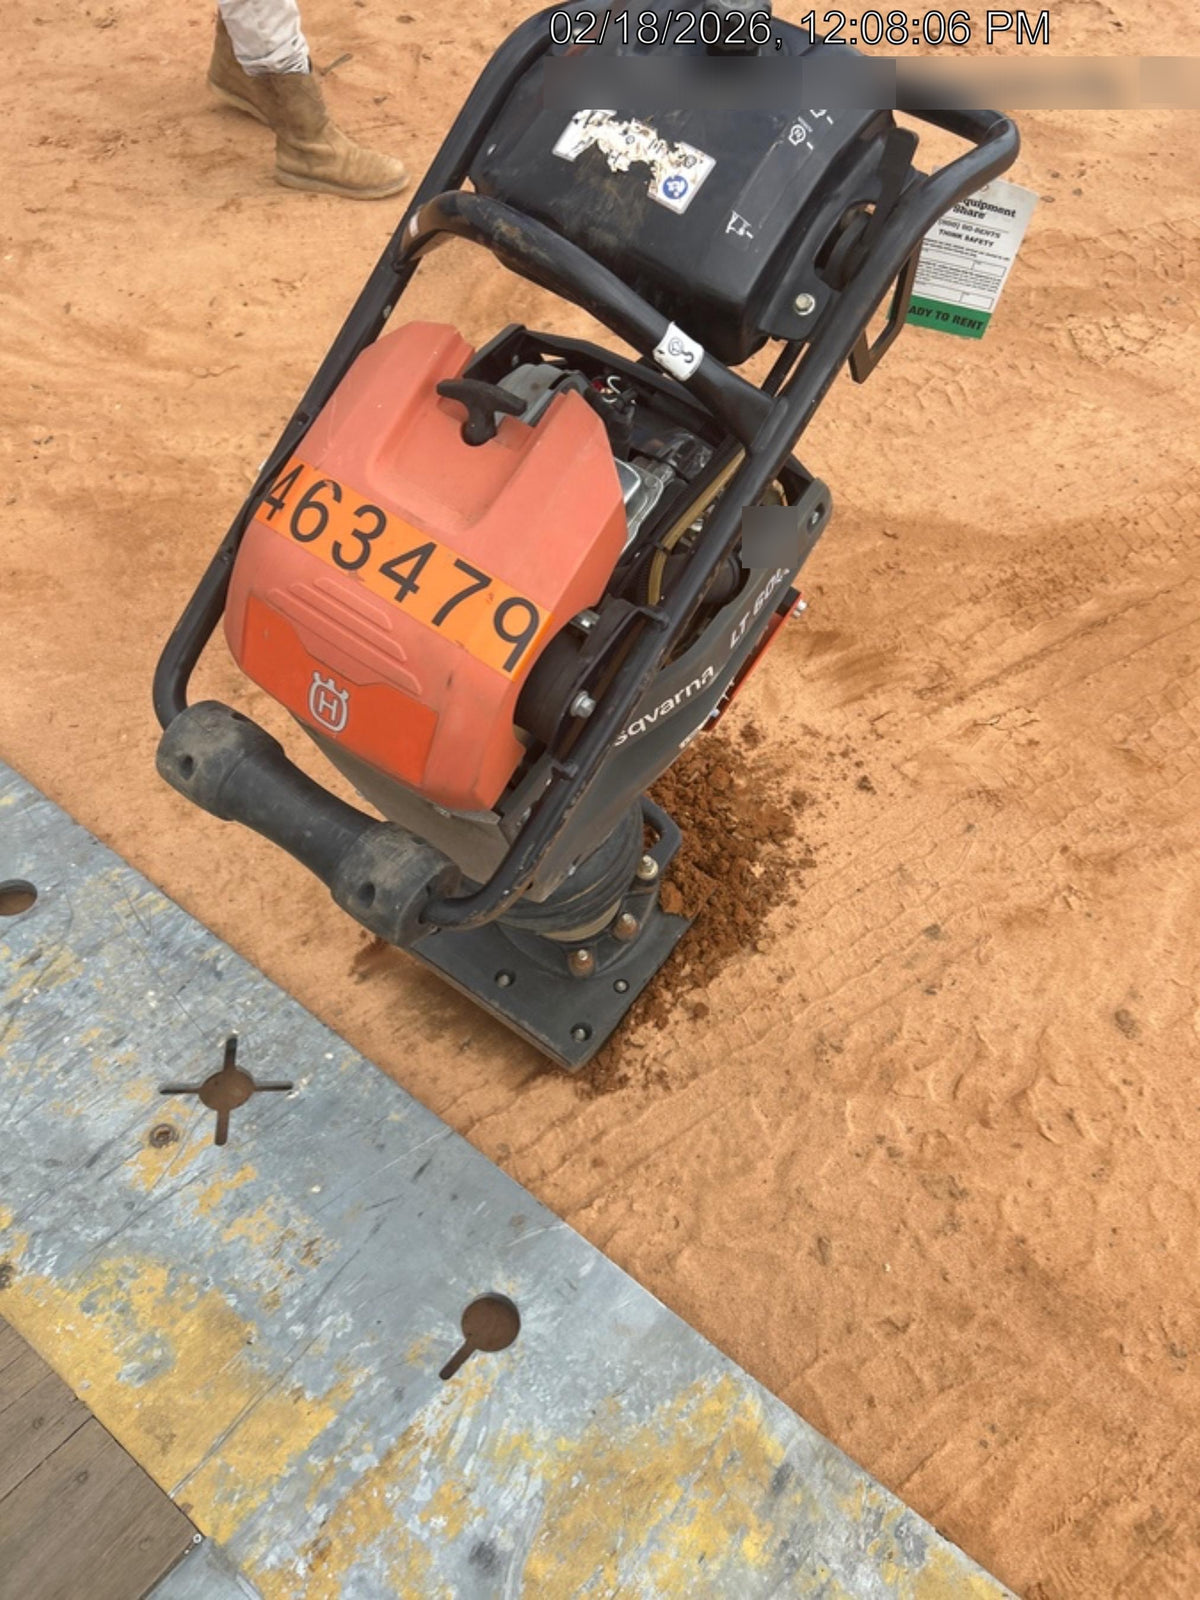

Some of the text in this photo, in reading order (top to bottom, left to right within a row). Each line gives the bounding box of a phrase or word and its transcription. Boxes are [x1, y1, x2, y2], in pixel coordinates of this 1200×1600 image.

[961, 198, 1016, 218] quipment
[964, 234, 994, 247] SAFETY
[908, 305, 984, 330] ADY TO RENT
[264, 463, 540, 673] 463479
